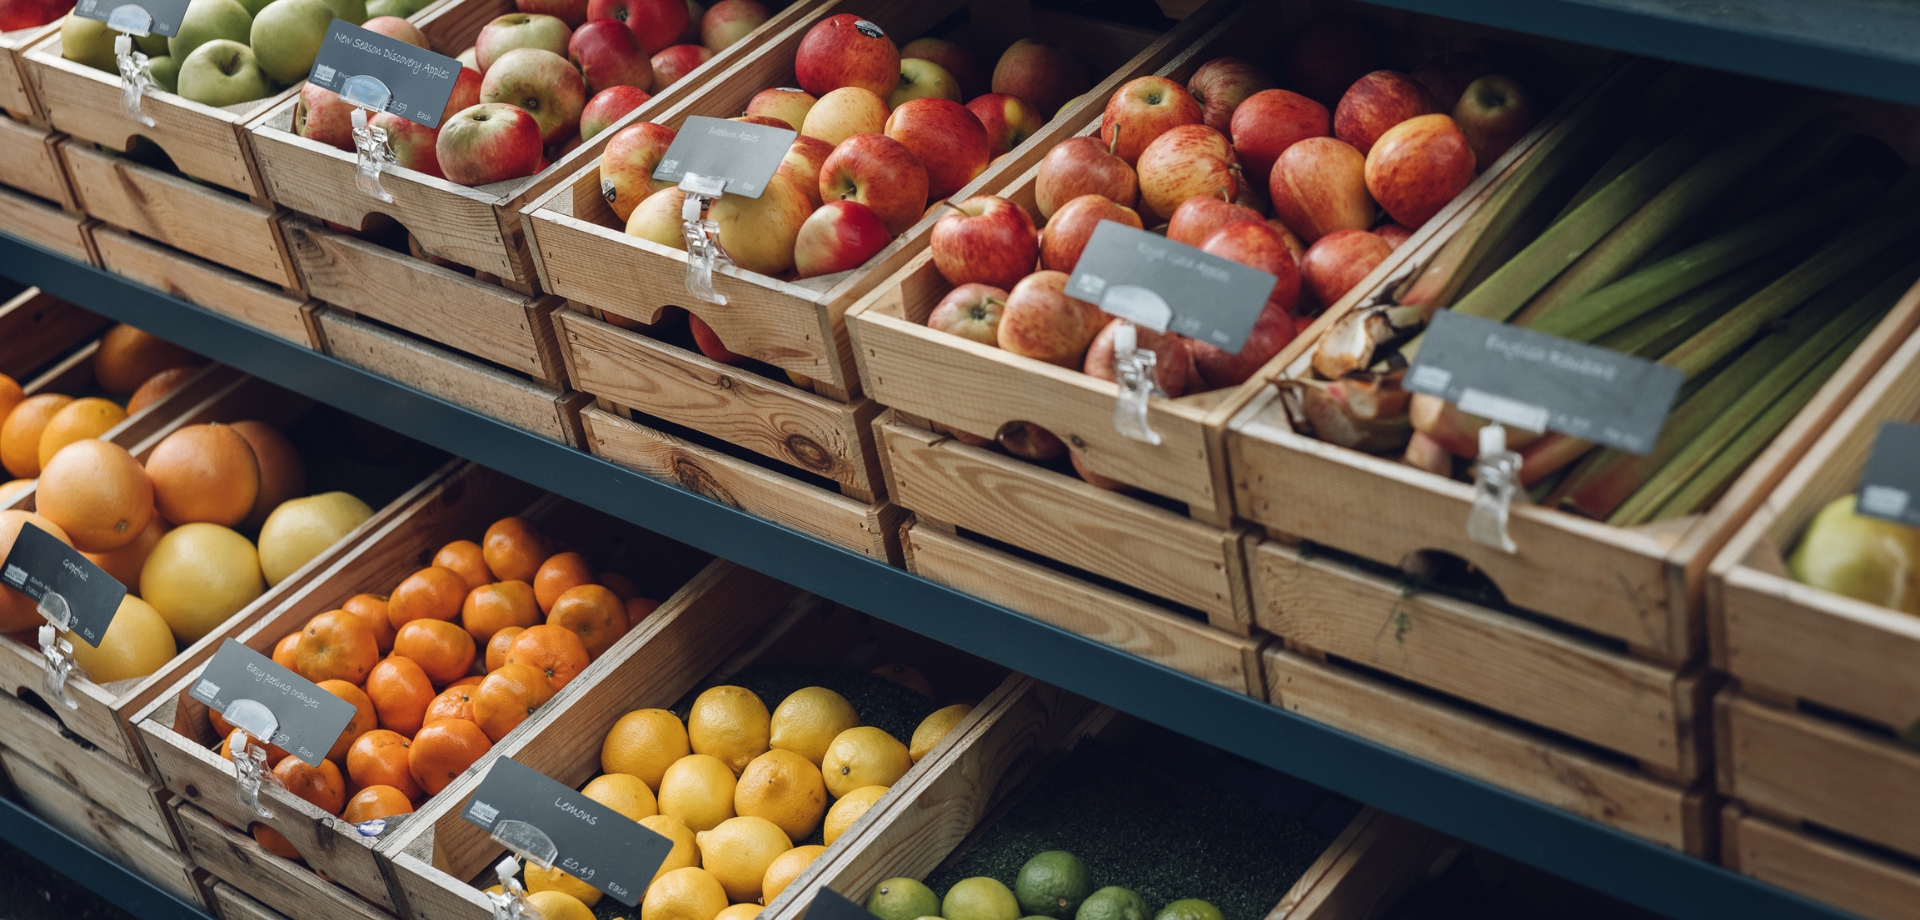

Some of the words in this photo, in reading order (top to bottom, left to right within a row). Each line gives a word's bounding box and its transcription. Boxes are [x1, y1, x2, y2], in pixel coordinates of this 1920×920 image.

[334, 32, 353, 45] New
[352, 38, 382, 56] Season
[383, 48, 422, 75] Discovery
[422, 62, 450, 80] Apples
[416, 110, 432, 122] Each
[246, 662, 266, 682] Easy
[265, 673, 292, 695] peeling
[290, 689, 320, 709] oranges
[298, 746, 314, 760] Each
[554, 797, 598, 826] Lemons
[562, 857, 596, 881] £0.49
[607, 881, 628, 897] Each
